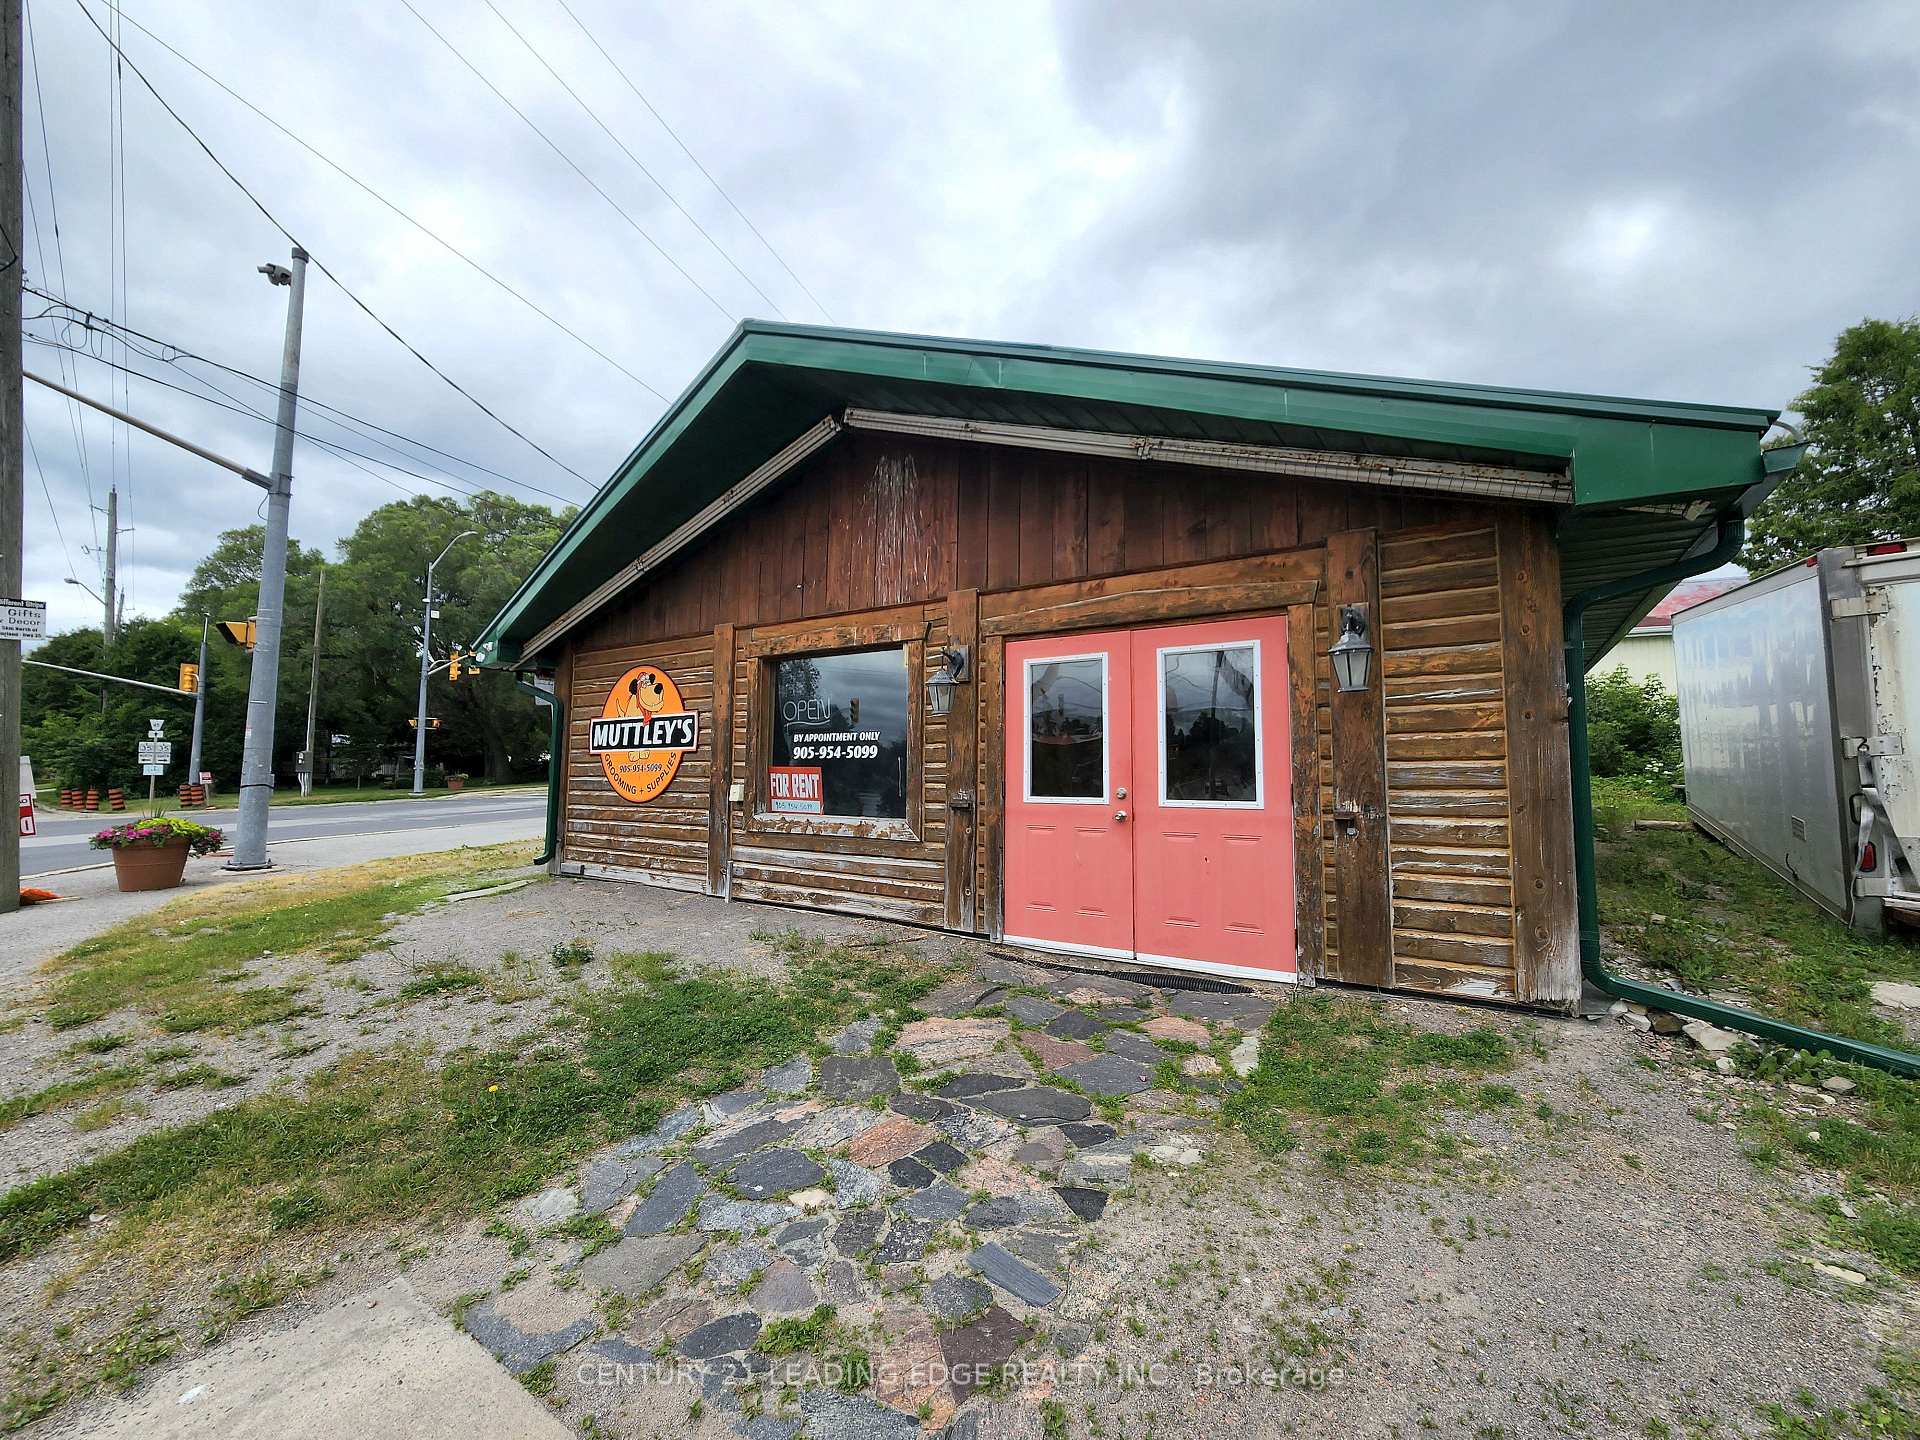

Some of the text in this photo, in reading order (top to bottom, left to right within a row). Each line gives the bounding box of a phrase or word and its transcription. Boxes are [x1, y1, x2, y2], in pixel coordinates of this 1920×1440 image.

[8, 609, 41, 617] Gifts
[9, 617, 41, 625] Decor
[783, 698, 831, 721] OPEN
[593, 719, 693, 747] MUTTLEY'S
[793, 731, 881, 743] BY APPOINTMENT ONLY
[793, 745, 879, 760] 905-954-5099
[604, 752, 637, 795] GROOMING
[646, 751, 678, 793] SUPPLIES
[619, 763, 663, 774] 905-954-5099
[770, 773, 820, 799] FOR RENT
